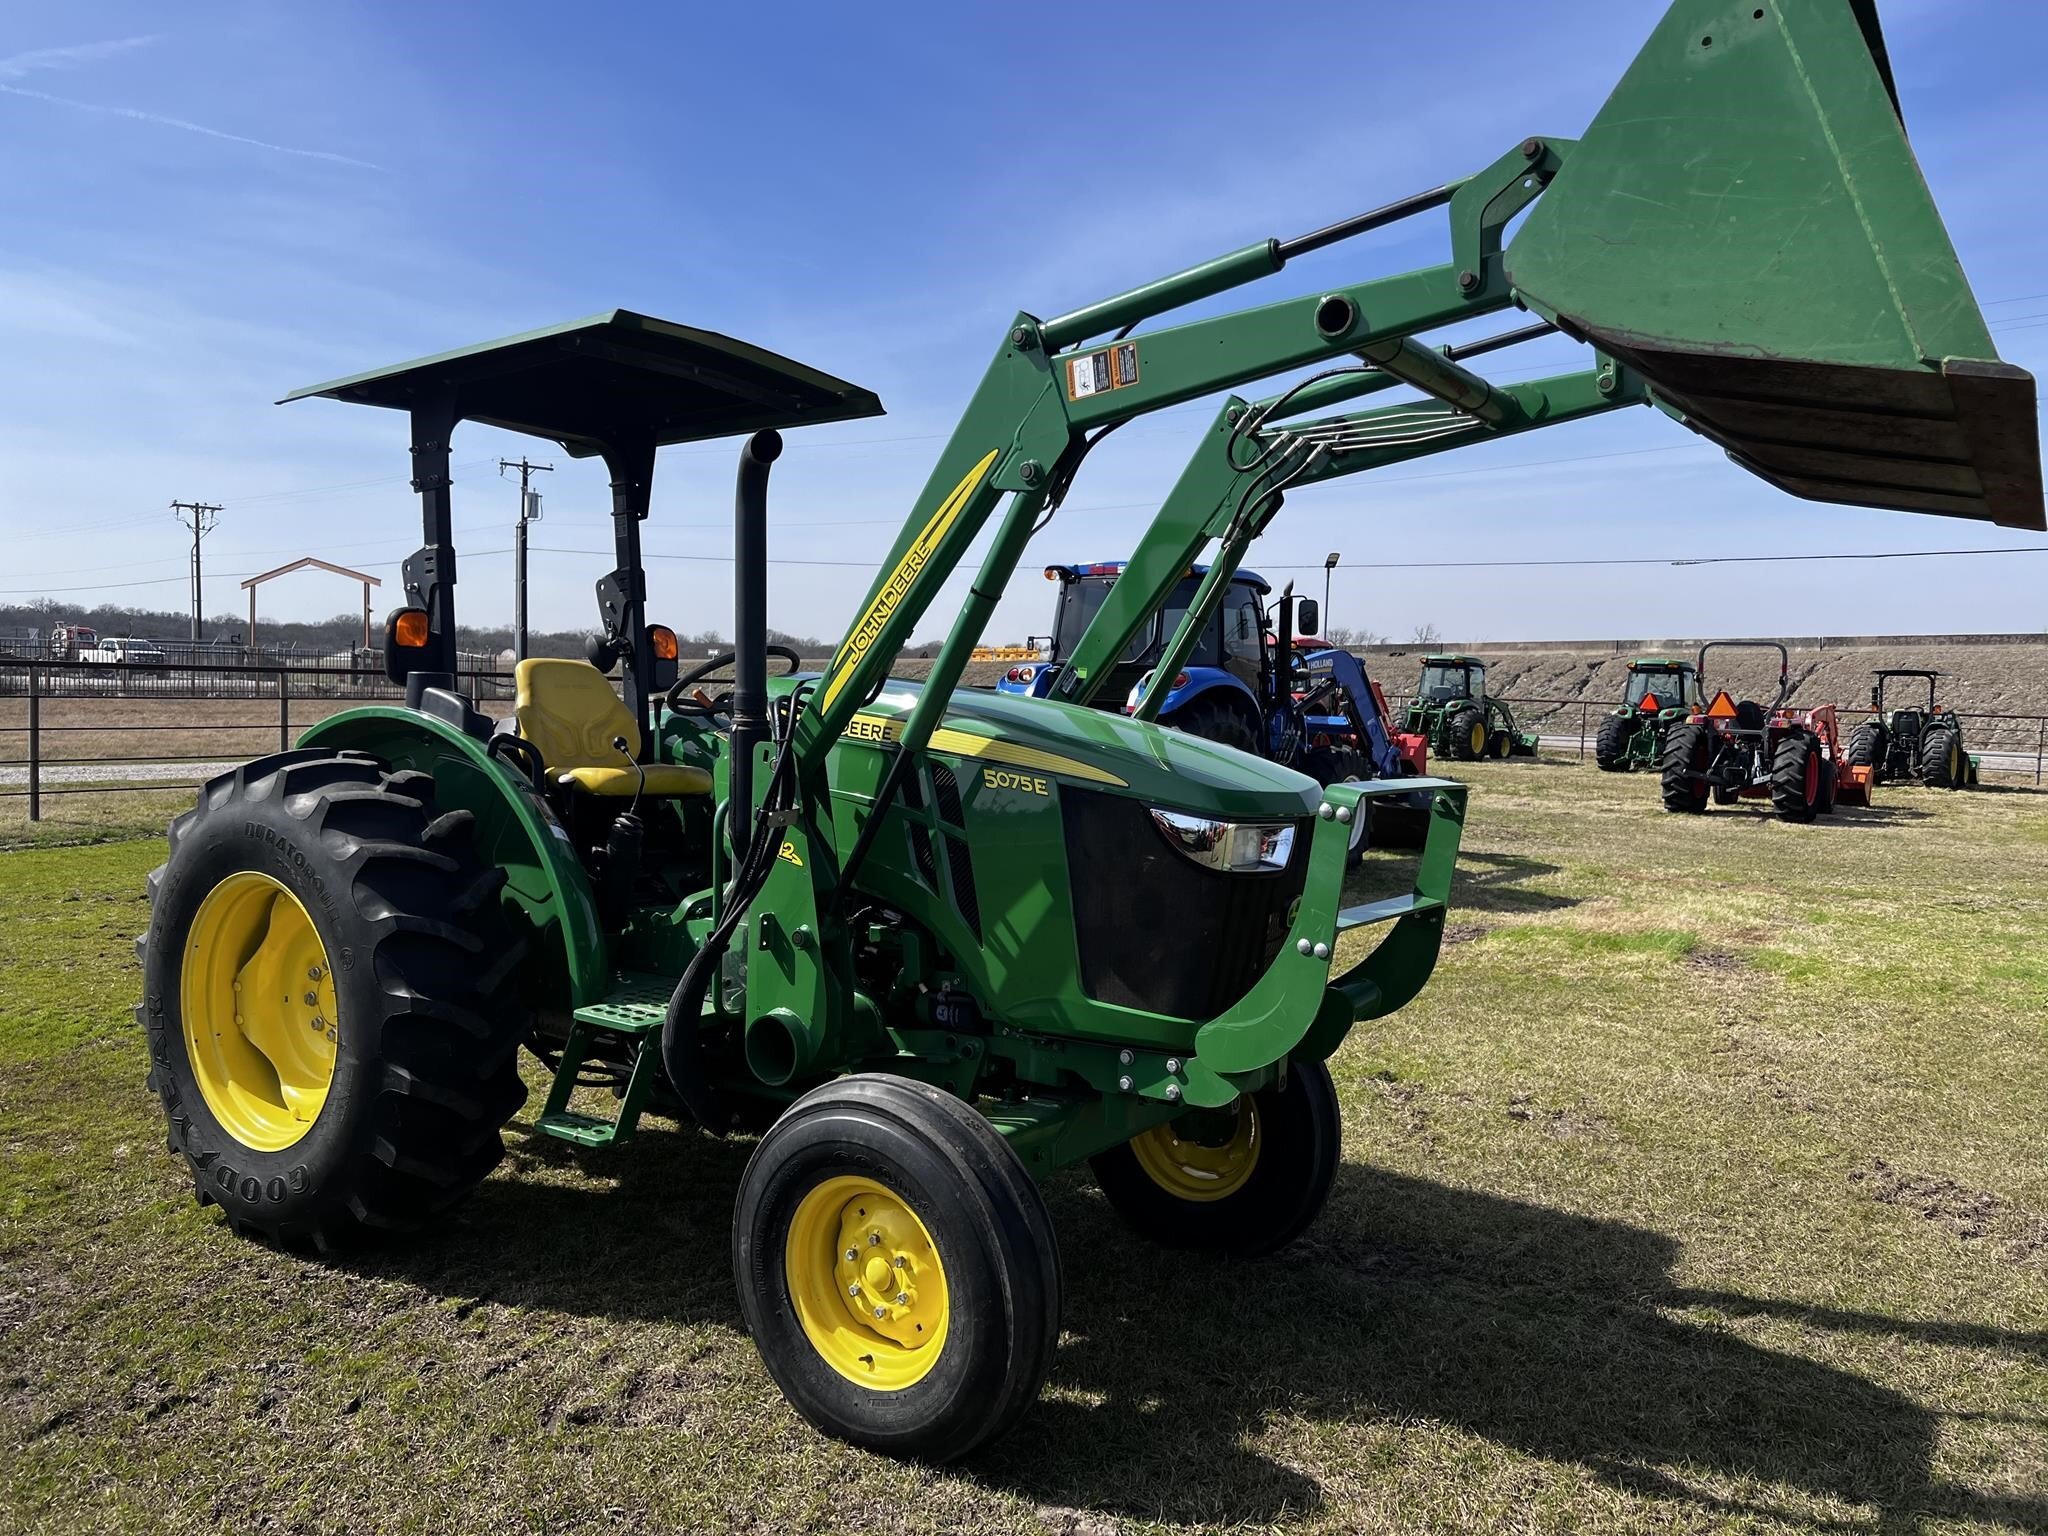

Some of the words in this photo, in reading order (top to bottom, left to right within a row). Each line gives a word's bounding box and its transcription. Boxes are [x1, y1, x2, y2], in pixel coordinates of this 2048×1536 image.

[849, 597, 890, 665] JOHN
[880, 542, 930, 612] DEERE
[1310, 659, 1333, 669] HOLLAND
[983, 769, 1049, 796] 5075E
